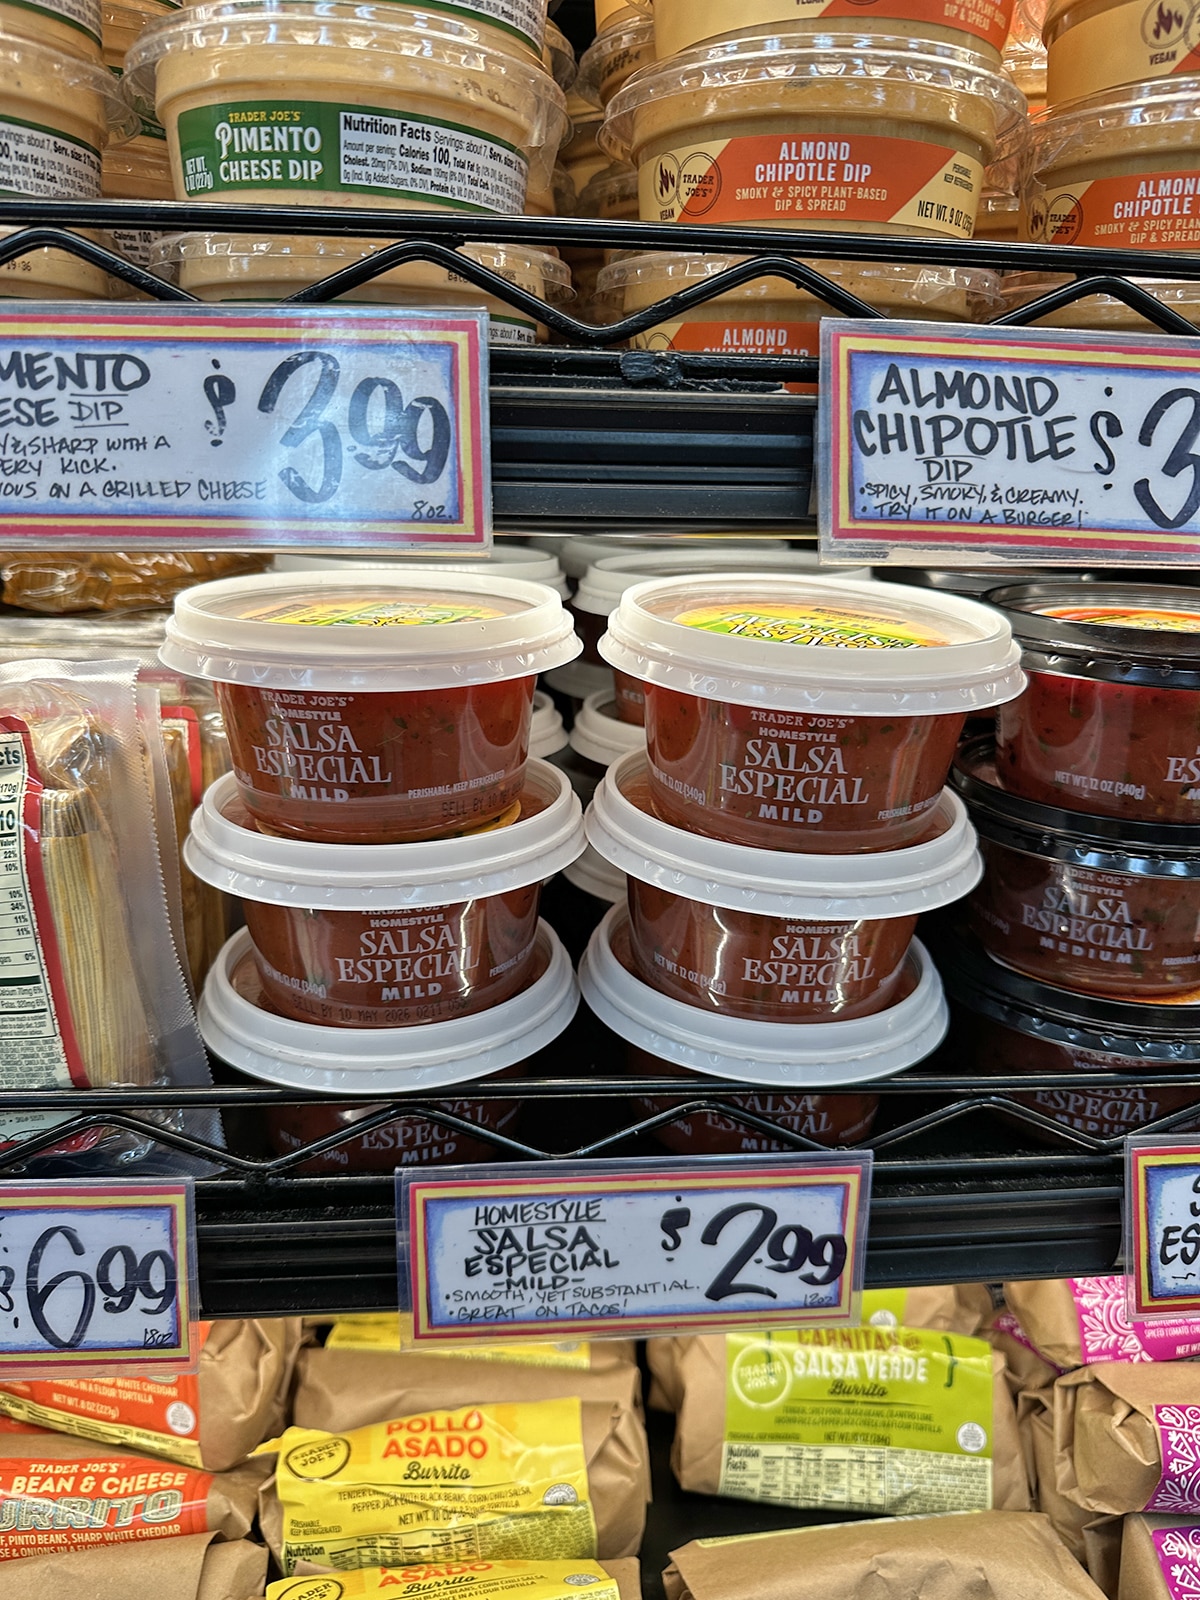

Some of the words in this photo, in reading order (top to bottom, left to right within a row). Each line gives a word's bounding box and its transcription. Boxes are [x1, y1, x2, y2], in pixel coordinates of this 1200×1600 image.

[1149, 49, 1177, 67] VEGAN
[228, 111, 267, 123] TRADER
[269, 110, 301, 122] JOE'S
[215, 122, 322, 160] PIMENTO
[343, 115, 397, 137] Nutrition
[400, 122, 432, 142] Facts
[434, 130, 465, 152] Servings:
[466, 139, 482, 156] about
[489, 145, 503, 164] Serv.
[343, 140, 365, 152] Amount
[399, 144, 430, 161] Calories
[433, 146, 451, 168] 100,
[453, 156, 467, 171] Total
[779, 141, 850, 162] ALMOND
[219, 159, 284, 183] CHEESE
[288, 159, 324, 182] DIP
[343, 154, 370, 167] Cholest.
[371, 158, 386, 171] 20mg
[411, 163, 432, 176] Sodium
[755, 162, 836, 183] CHIPOTLE
[843, 163, 872, 183] DIP
[430, 181, 449, 193] Protein
[682, 174, 714, 185] TRADER
[685, 186, 708, 198] JOE'S
[736, 186, 769, 200] SMOKY
[788, 185, 818, 199] SPICY
[821, 186, 887, 201] PLANT-BASED
[659, 207, 675, 221] VEGAN
[775, 199, 792, 211] DIP
[795, 200, 804, 211] &
[807, 199, 846, 212] SPREAD
[917, 200, 935, 219] NET
[936, 203, 948, 222] WT.
[954, 209, 963, 227] OZ
[1113, 197, 1193, 219] CHIPOTLE
[1094, 222, 1126, 236] SMOKY
[1143, 219, 1173, 232] SPICY
[1130, 232, 1147, 244] DIP
[722, 328, 788, 347] ALMOND
[877, 363, 1059, 417] ALMOND
[68, 400, 124, 422] DIP
[106, 437, 148, 452] WITH
[154, 435, 171, 450] A
[854, 410, 1078, 464] CHIPOTLE
[60, 456, 117, 475] KICK.
[923, 458, 974, 483] DIP
[49, 482, 70, 498] ON
[79, 482, 97, 498] A
[103, 480, 191, 499] GRILLED
[198, 478, 268, 500] CHEESE
[920, 484, 987, 504] SMOKY,
[1005, 488, 1085, 505] CREAMY.
[873, 501, 913, 520] TRY
[925, 506, 945, 521] IT
[948, 505, 972, 522] ON
[980, 509, 998, 525] A
[1003, 508, 1084, 530] BURGER!
[261, 690, 307, 707] TRADER
[271, 706, 342, 722] HOMESTYLE
[751, 710, 804, 727] TRADER
[265, 719, 363, 753] SALSA
[759, 726, 837, 743] HOMESTYLE
[252, 745, 392, 784] ESPECIAL
[745, 739, 848, 775] SALSA
[290, 784, 350, 803] MILD
[408, 784, 452, 799] PERISHABLE,
[453, 781, 469, 793] KEEP
[469, 769, 505, 788] REFRIGERATED
[683, 783, 706, 806] (340g)
[718, 762, 869, 805] ESPECIAL
[1055, 770, 1070, 784] NET
[1100, 780, 1113, 793] OZ
[1114, 781, 1145, 801] (340g)
[441, 801, 468, 818] SELL
[758, 804, 824, 824] MILD
[1049, 863, 1094, 881] TRADER
[1043, 886, 1133, 925] SALSA
[370, 913, 445, 929] HOMESTYLE
[1021, 902, 1153, 951] ESPECIAL
[360, 924, 458, 957] SALSA
[770, 935, 862, 961] SALSA
[1039, 936, 1132, 964] MEDIUM
[335, 946, 480, 985] ESPECIAL
[654, 952, 667, 970] NET
[688, 969, 698, 983] OZ
[741, 957, 876, 987] ESPECAL
[381, 982, 442, 1001] MILD
[780, 989, 839, 1004] MILD
[358, 1008, 378, 1022] MAY
[385, 1008, 411, 1022] 2026
[401, 1142, 457, 1164] MILD
[474, 1198, 603, 1226] HOMESTYLE
[474, 1225, 600, 1254] SALSA
[464, 1249, 619, 1277] ESPECIAL
[453, 1287, 534, 1304] SMOOTH,
[535, 1288, 571, 1303] YET
[572, 1279, 700, 1300] SUBSTANTIAL.
[457, 1304, 525, 1321] GREAT
[535, 1305, 559, 1318] ON
[565, 1299, 628, 1318] TACOS!
[793, 1350, 860, 1378] SALSA
[864, 1354, 929, 1382] VERDE
[142, 1382, 179, 1398] CHEDDAR
[829, 1379, 888, 1397] Burrito
[386, 1410, 485, 1436] POLLO
[383, 1436, 488, 1460] ASADO
[29, 1463, 80, 1474] TRADER
[403, 1461, 471, 1481] Burrito
[11, 1476, 75, 1494] BEAN
[80, 1476, 96, 1492] &
[101, 1472, 188, 1494] CHEESE
[352, 1499, 381, 1513] PEPPER
[382, 1499, 401, 1510] JACK
[420, 1492, 444, 1502] BLACK
[399, 1512, 415, 1526] NET
[9, 1534, 36, 1546] PINTO
[38, 1533, 71, 1545] BEANS,
[72, 1531, 103, 1543] SHARP
[104, 1530, 135, 1541] WHITE
[136, 1524, 181, 1538] CHEDDAR
[286, 1544, 326, 1558] Nutrition
[378, 1562, 493, 1588] ASADO
[403, 1574, 478, 1595] Burrito
